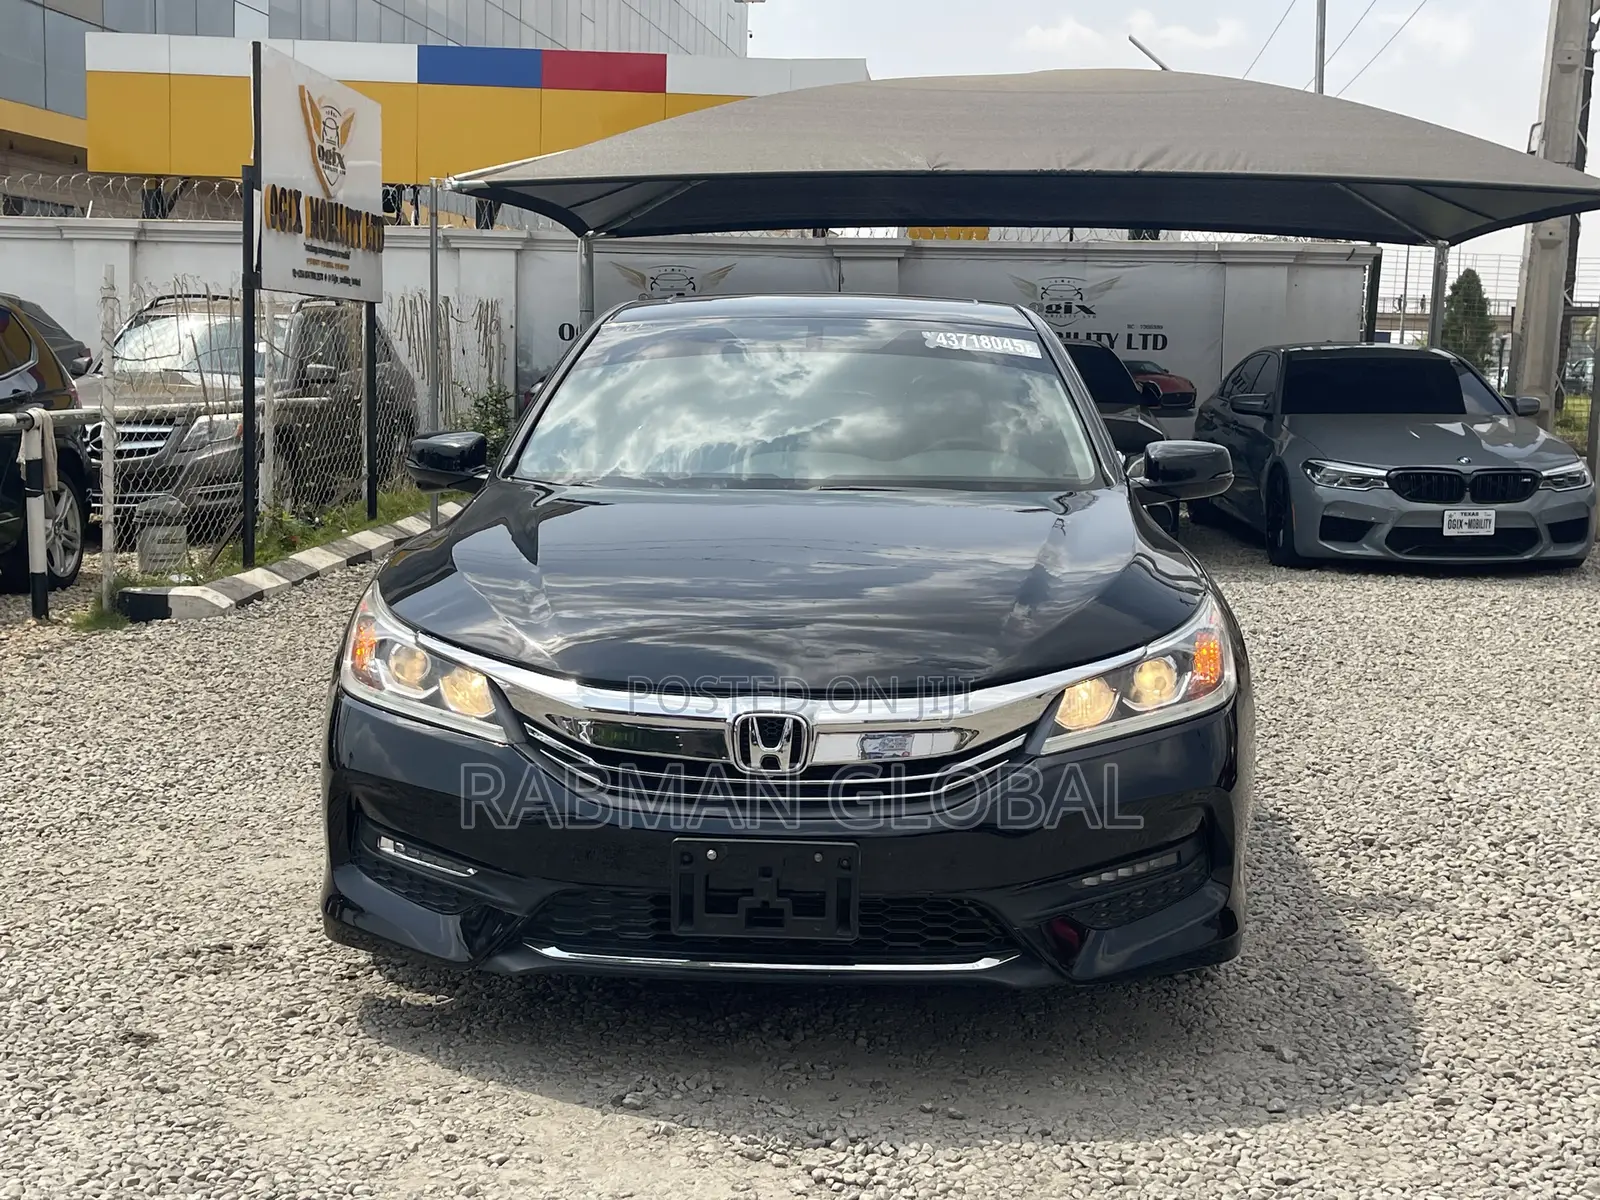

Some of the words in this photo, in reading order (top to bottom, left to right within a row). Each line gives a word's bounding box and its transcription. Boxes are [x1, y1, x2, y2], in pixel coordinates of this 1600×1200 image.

[265, 184, 303, 235] OGIX
[936, 332, 1025, 354] 43718045
[1126, 333, 1168, 351] LTD
